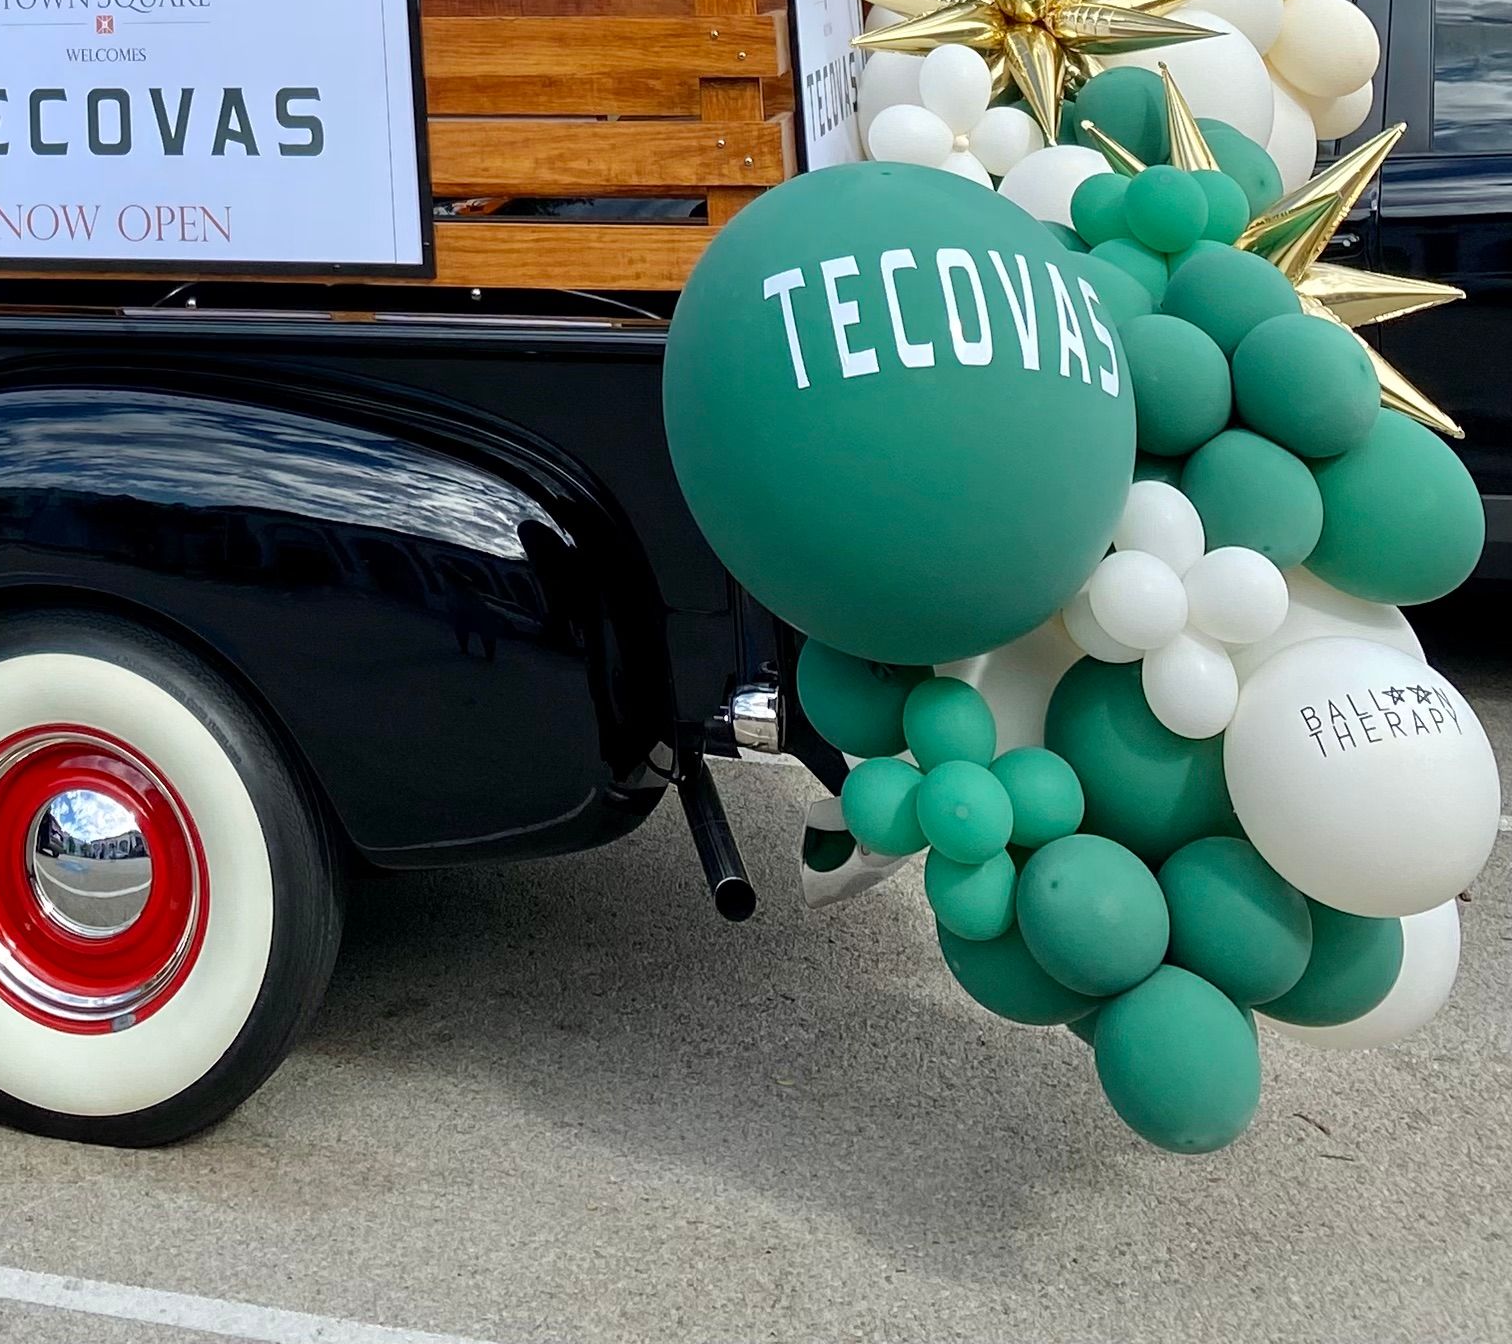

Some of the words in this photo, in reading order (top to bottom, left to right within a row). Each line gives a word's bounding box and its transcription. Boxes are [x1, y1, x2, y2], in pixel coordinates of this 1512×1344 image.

[66, 48, 147, 63] WELCOMES
[807, 52, 858, 142] TECOVAS
[117, 204, 232, 243] OPEN
[763, 247, 1121, 398] TECOVAS
[1309, 707, 1462, 758] THERAPY
